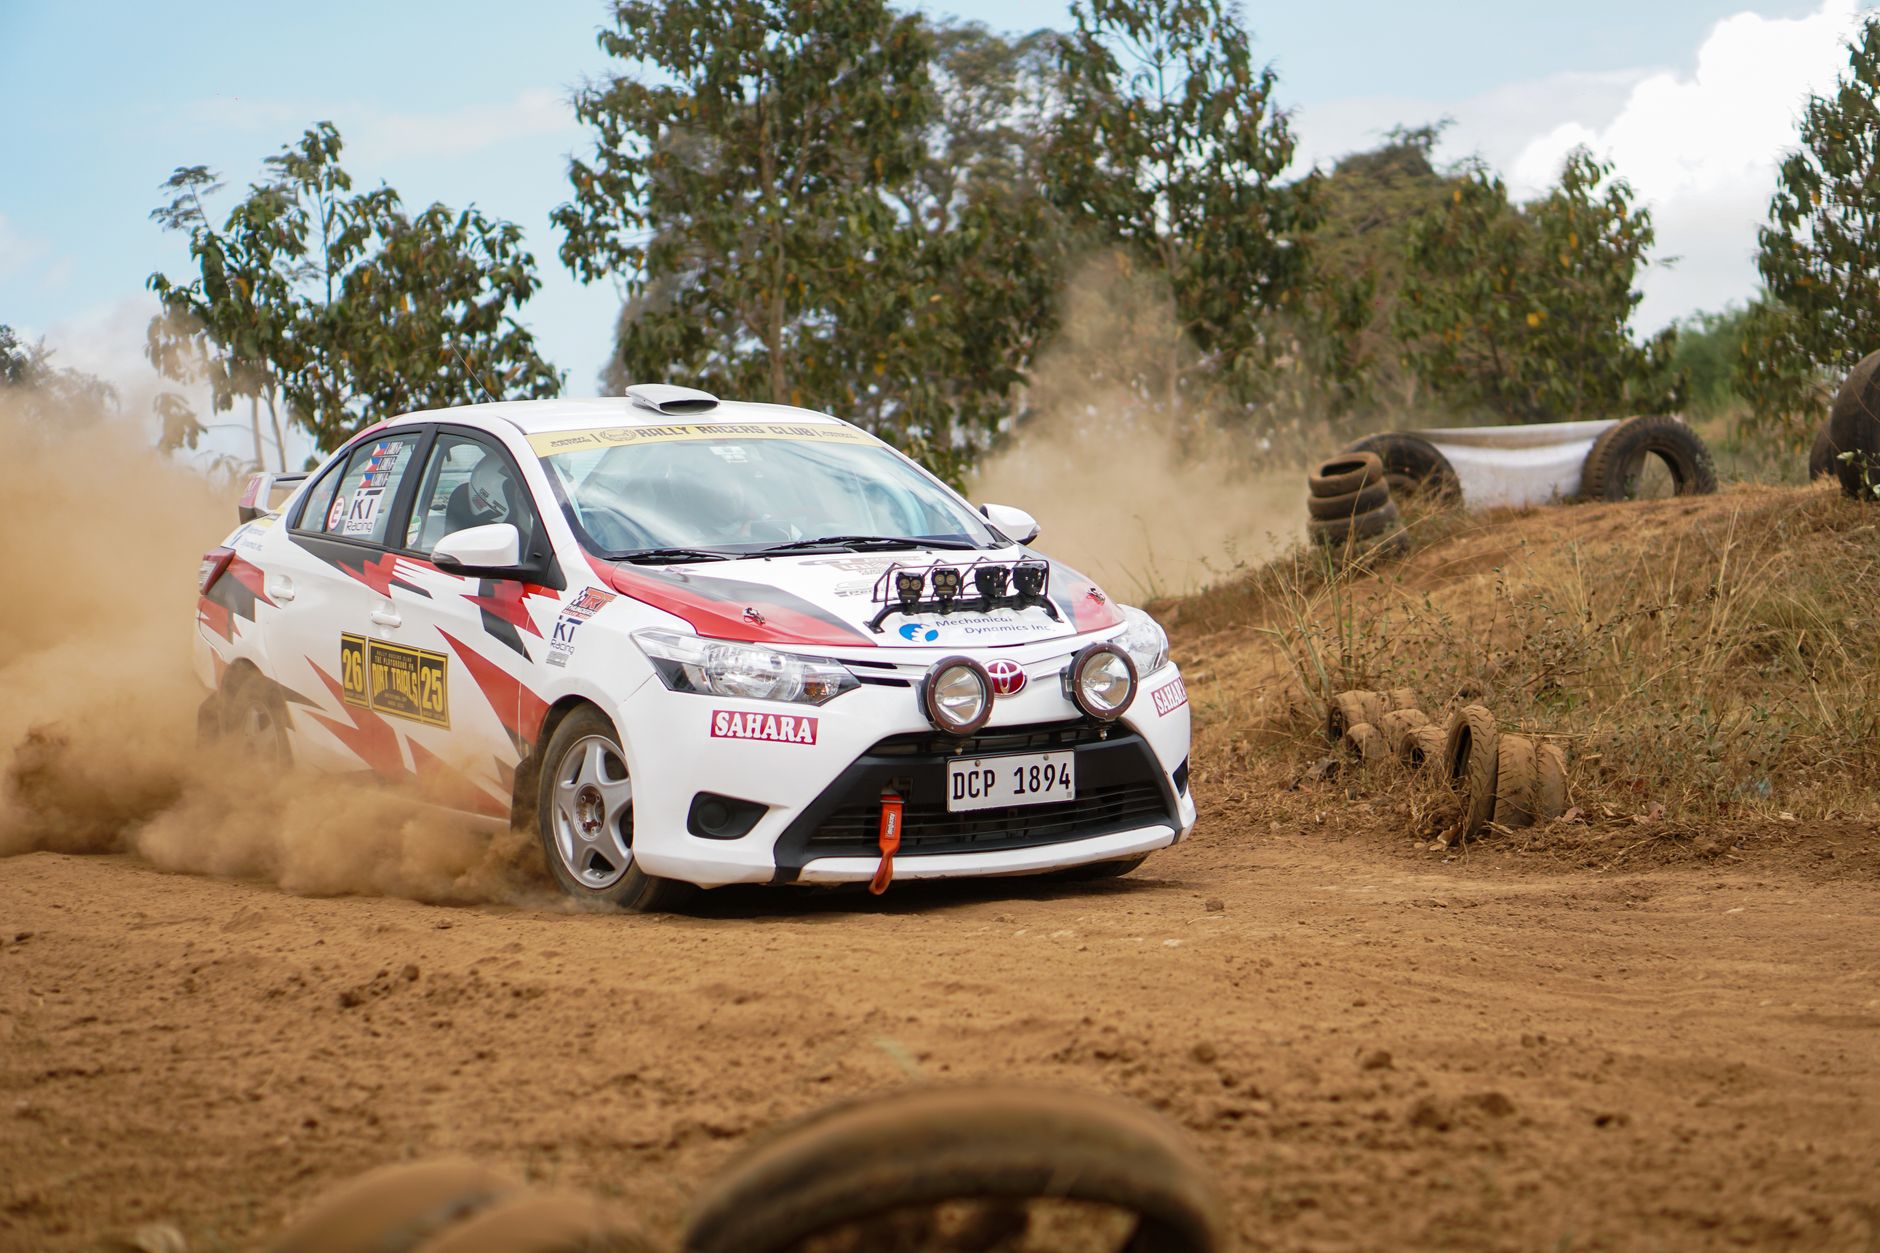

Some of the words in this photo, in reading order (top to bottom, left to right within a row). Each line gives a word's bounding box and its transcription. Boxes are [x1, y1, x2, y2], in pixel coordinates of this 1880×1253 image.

[635, 427, 691, 438] RALLY
[696, 425, 766, 435] RACERS
[768, 426, 816, 437] CLUB
[331, 502, 343, 524] E
[346, 520, 373, 533] Racing
[964, 623, 1029, 634] Dynamics
[550, 639, 575, 656] Racing
[342, 648, 364, 693] 26
[391, 667, 419, 708] TRIALS
[421, 666, 444, 713] 25
[714, 711, 814, 744] SAHARA
[953, 769, 996, 800] DCP
[1013, 763, 1071, 795] 1894
